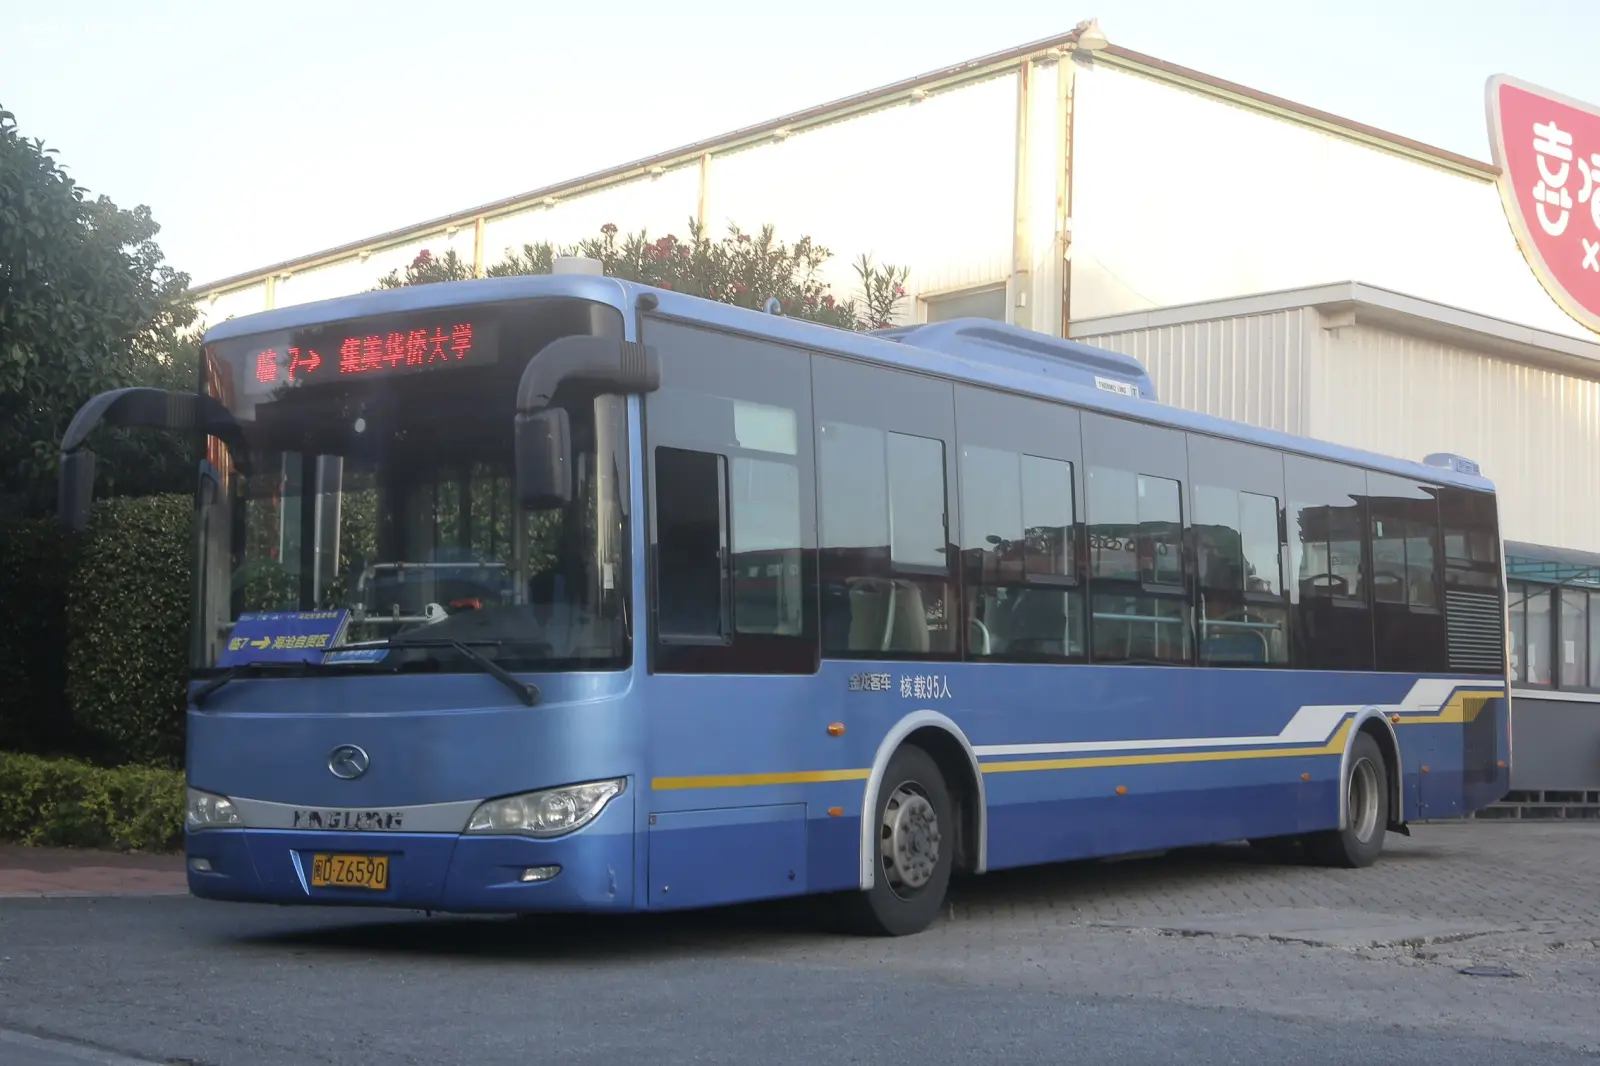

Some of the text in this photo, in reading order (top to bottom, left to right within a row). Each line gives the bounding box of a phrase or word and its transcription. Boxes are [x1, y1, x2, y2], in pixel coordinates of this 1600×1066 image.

[339, 323, 472, 373] 集美华侨大学
[848, 673, 892, 691] 金龙客车
[900, 675, 952, 699] 核载95人
